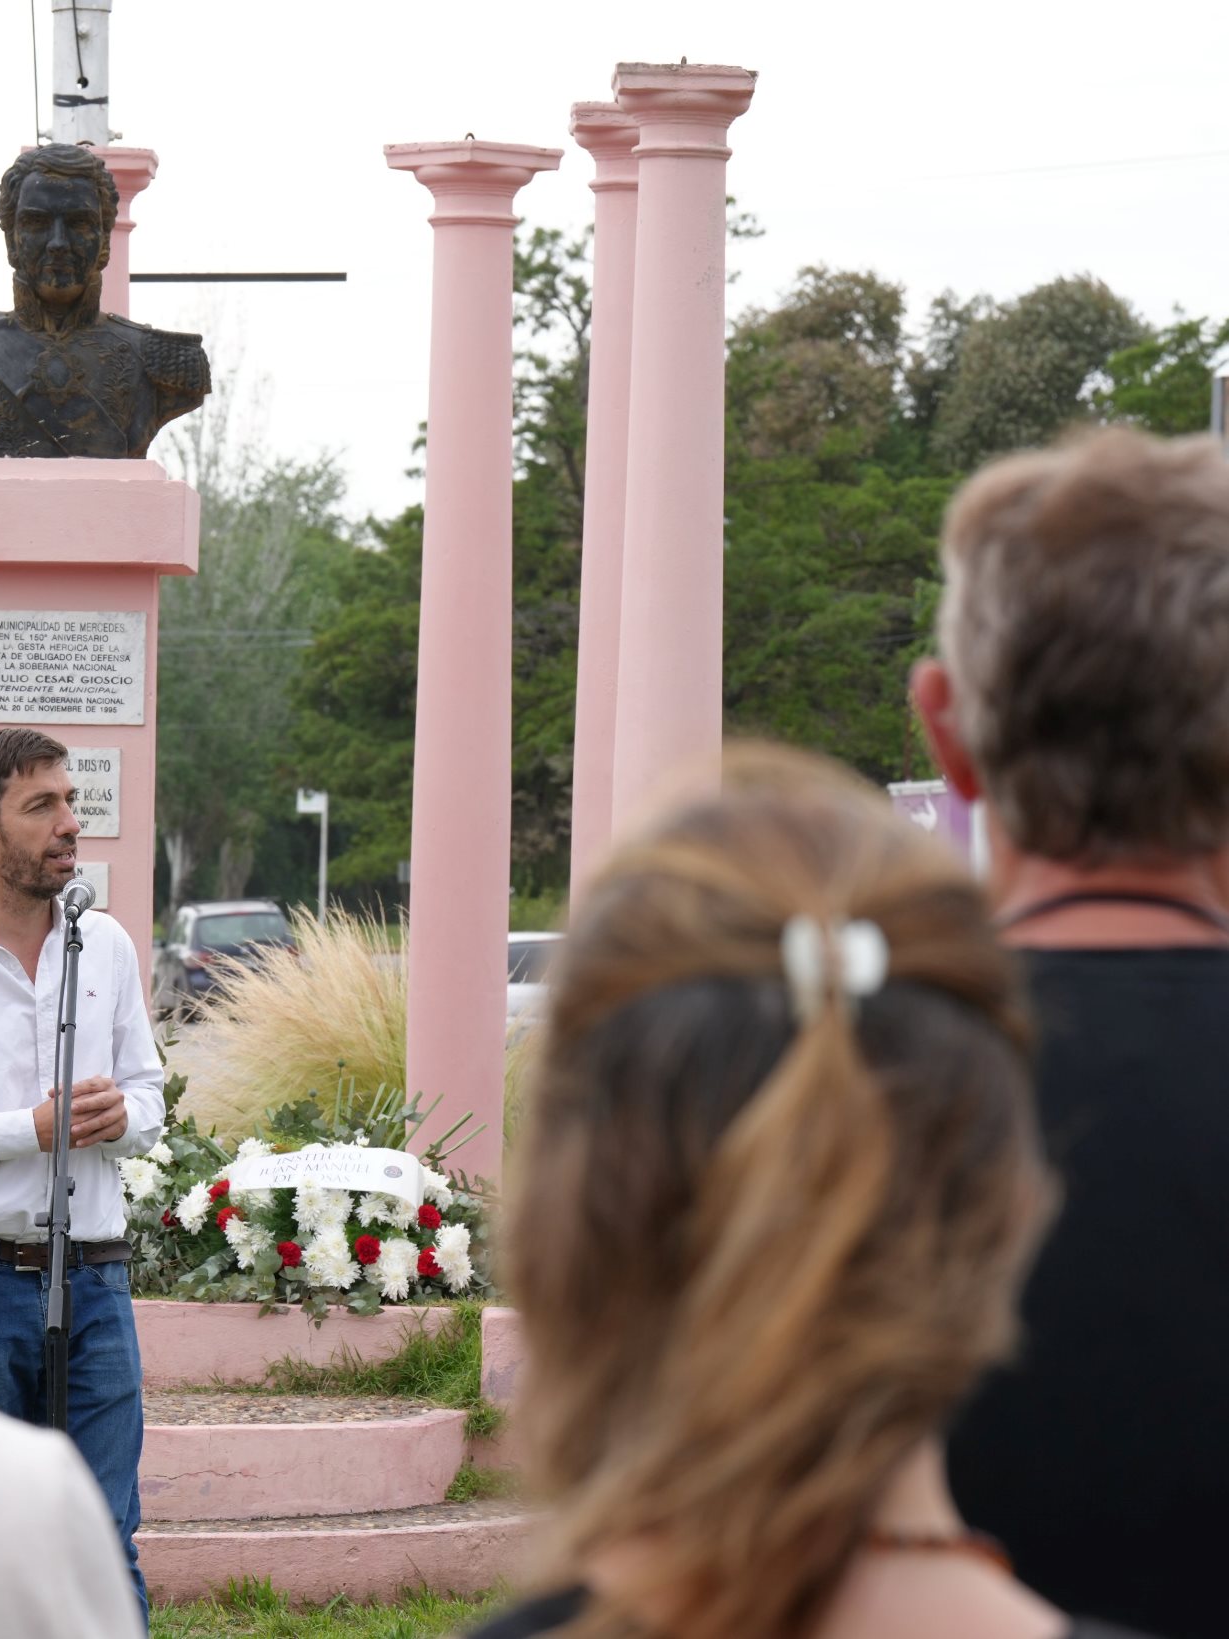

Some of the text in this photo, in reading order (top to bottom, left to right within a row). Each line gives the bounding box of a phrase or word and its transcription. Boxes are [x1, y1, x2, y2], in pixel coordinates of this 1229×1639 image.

[64, 622, 75, 632] DE
[80, 623, 125, 632] MERCEDES
[52, 634, 109, 642] ANIVERSARIO
[18, 643, 45, 651] GESTA
[49, 644, 89, 652] HEROICA
[27, 653, 73, 661] OBLIGADO
[91, 654, 130, 662] DEFENSA
[19, 662, 68, 670] SOBERANIA
[35, 675, 74, 683] CESAR
[81, 676, 133, 685] GIOSCIO
[40, 696, 83, 704] SOBERANIA
[87, 697, 125, 705] NACIONAL
[78, 760, 111, 772] BUSTO
[84, 789, 113, 801] ROSAS
[81, 806, 112, 815] NACIONAL
